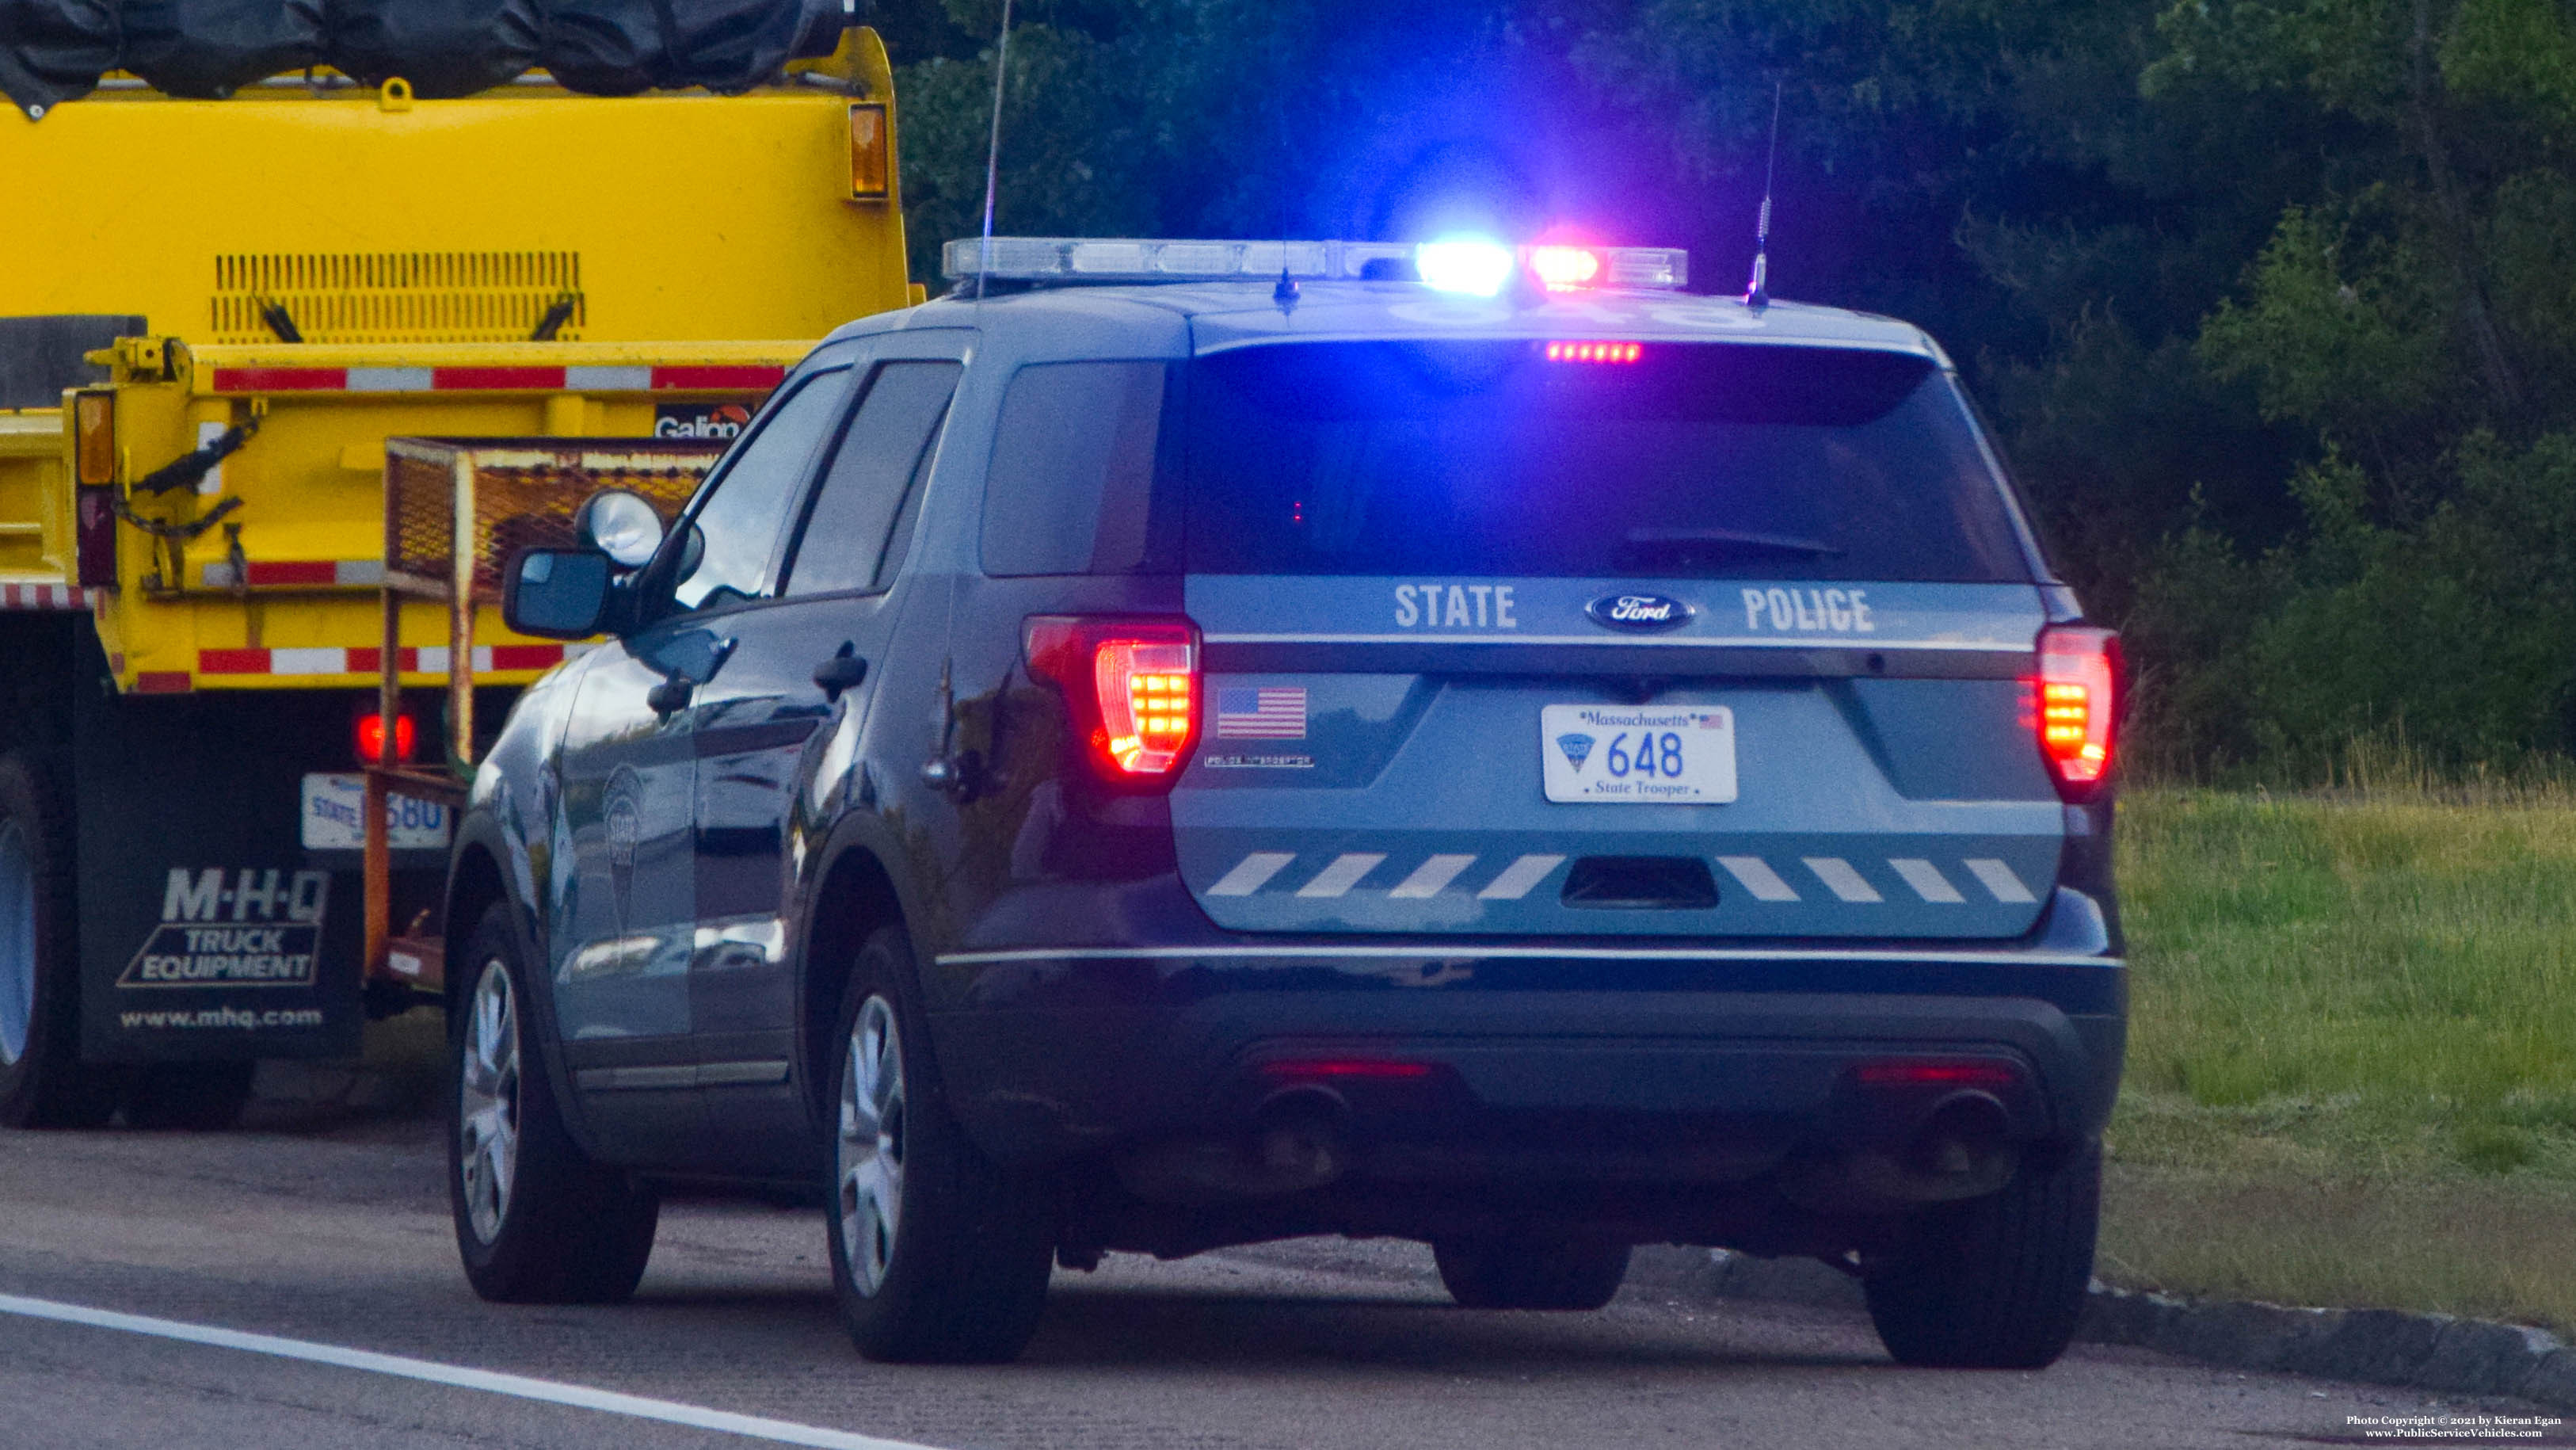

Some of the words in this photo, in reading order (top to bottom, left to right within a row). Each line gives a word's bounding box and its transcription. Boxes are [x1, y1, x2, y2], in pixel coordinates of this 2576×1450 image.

[1395, 584, 1517, 628] STATE
[1611, 596, 1671, 621] Ford
[1743, 588, 1875, 632] POLICE
[1587, 711, 1689, 727] Massachusetts
[1607, 731, 1683, 779] 648
[1595, 780, 1632, 794] State
[1636, 780, 1690, 798] Trooper
[185, 929, 284, 952] TRUCK
[141, 954, 311, 980] EQUIPMENT
[120, 1005, 323, 1030] www.mhq.com
